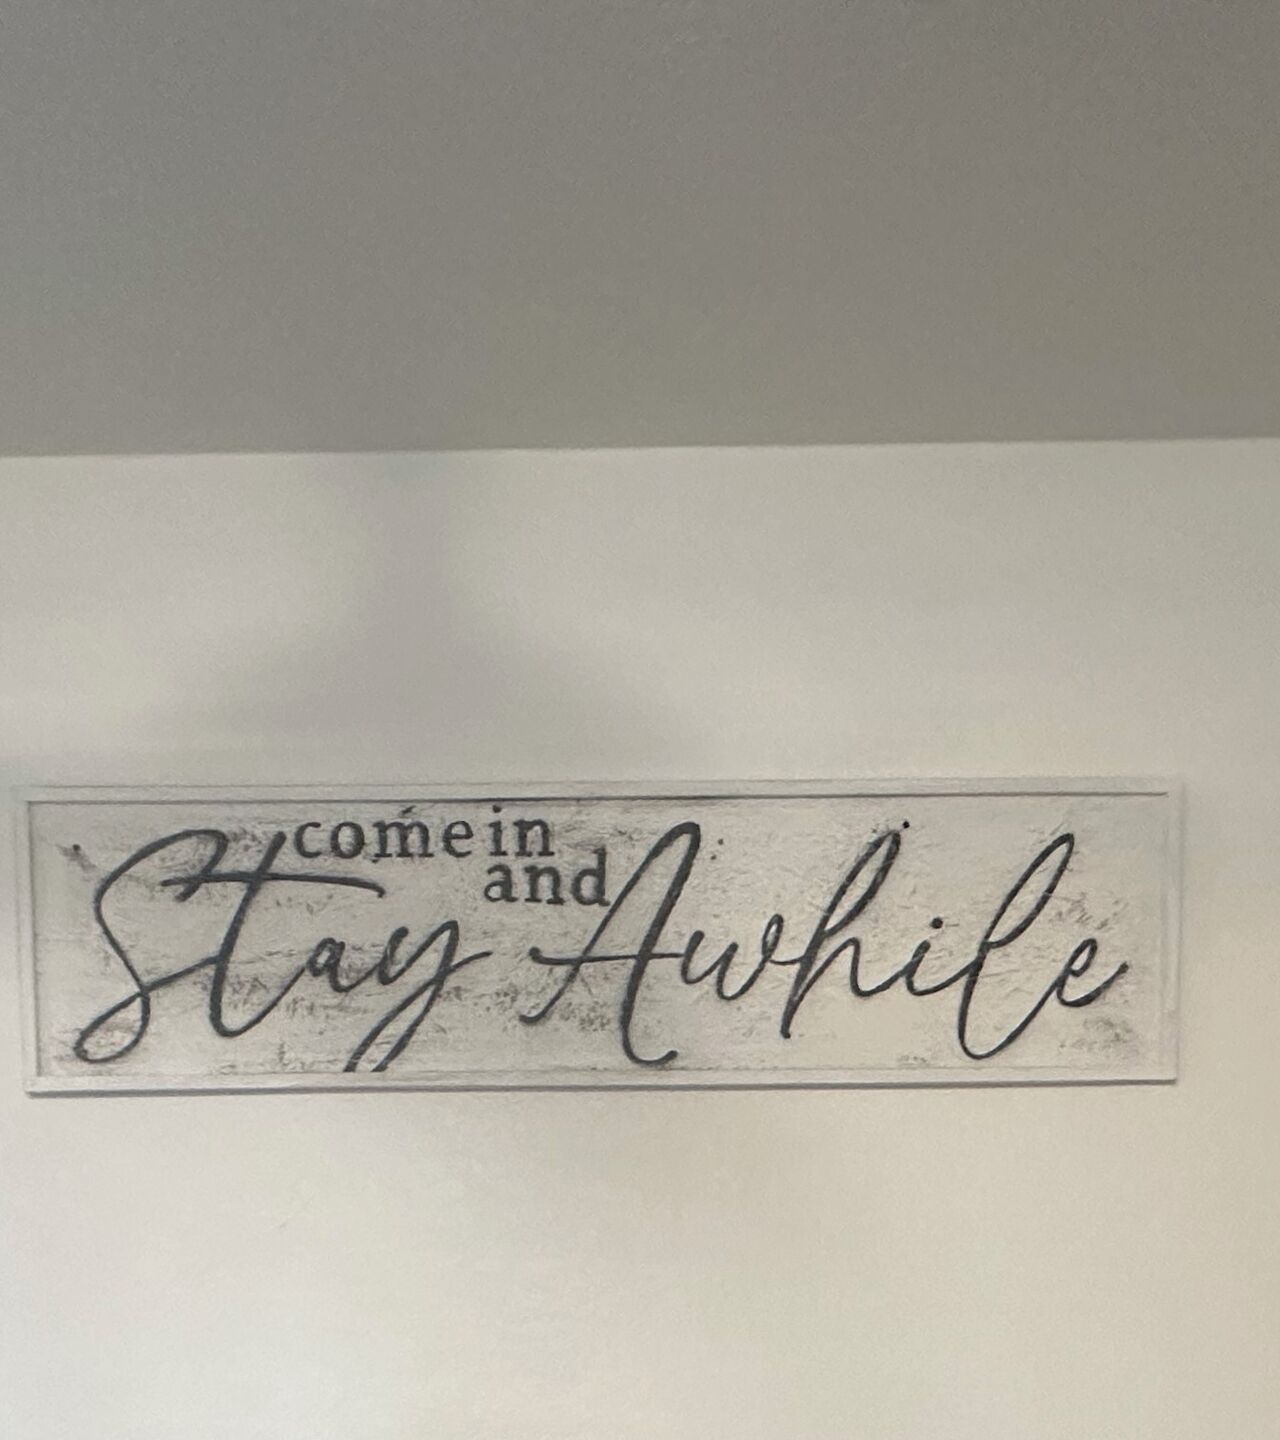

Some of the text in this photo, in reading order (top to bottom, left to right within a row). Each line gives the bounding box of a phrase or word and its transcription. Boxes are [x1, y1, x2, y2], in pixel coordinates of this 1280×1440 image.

[292, 806, 556, 861] come in
[483, 846, 611, 906] and
[74, 821, 1128, 1072] Stay Awhile
